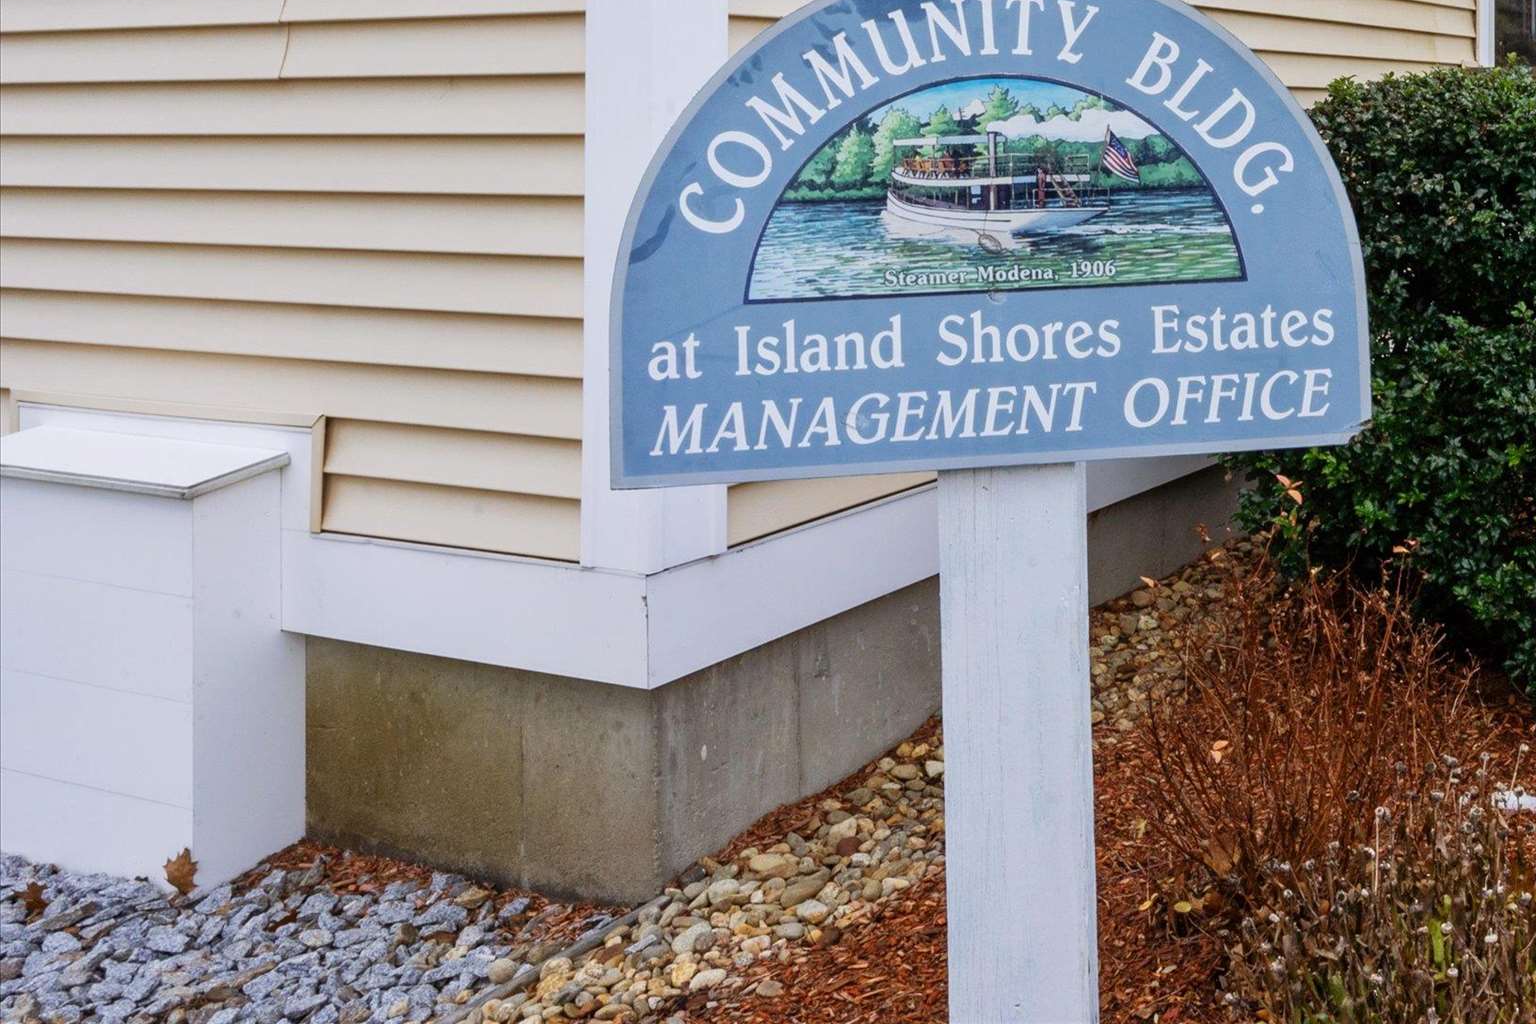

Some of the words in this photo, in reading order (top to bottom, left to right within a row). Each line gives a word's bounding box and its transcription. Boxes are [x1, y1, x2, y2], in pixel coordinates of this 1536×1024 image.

[1126, 32, 1294, 215] BLDG.
[884, 268, 967, 287] Steamer
[1070, 259, 1117, 278] 1906
[648, 338, 702, 380] at
[735, 314, 905, 376] Island
[937, 311, 1121, 367] Shores
[1152, 305, 1335, 354] Estates
[649, 381, 1097, 456] MANAGEMENT
[1124, 368, 1332, 429] OFFICE
